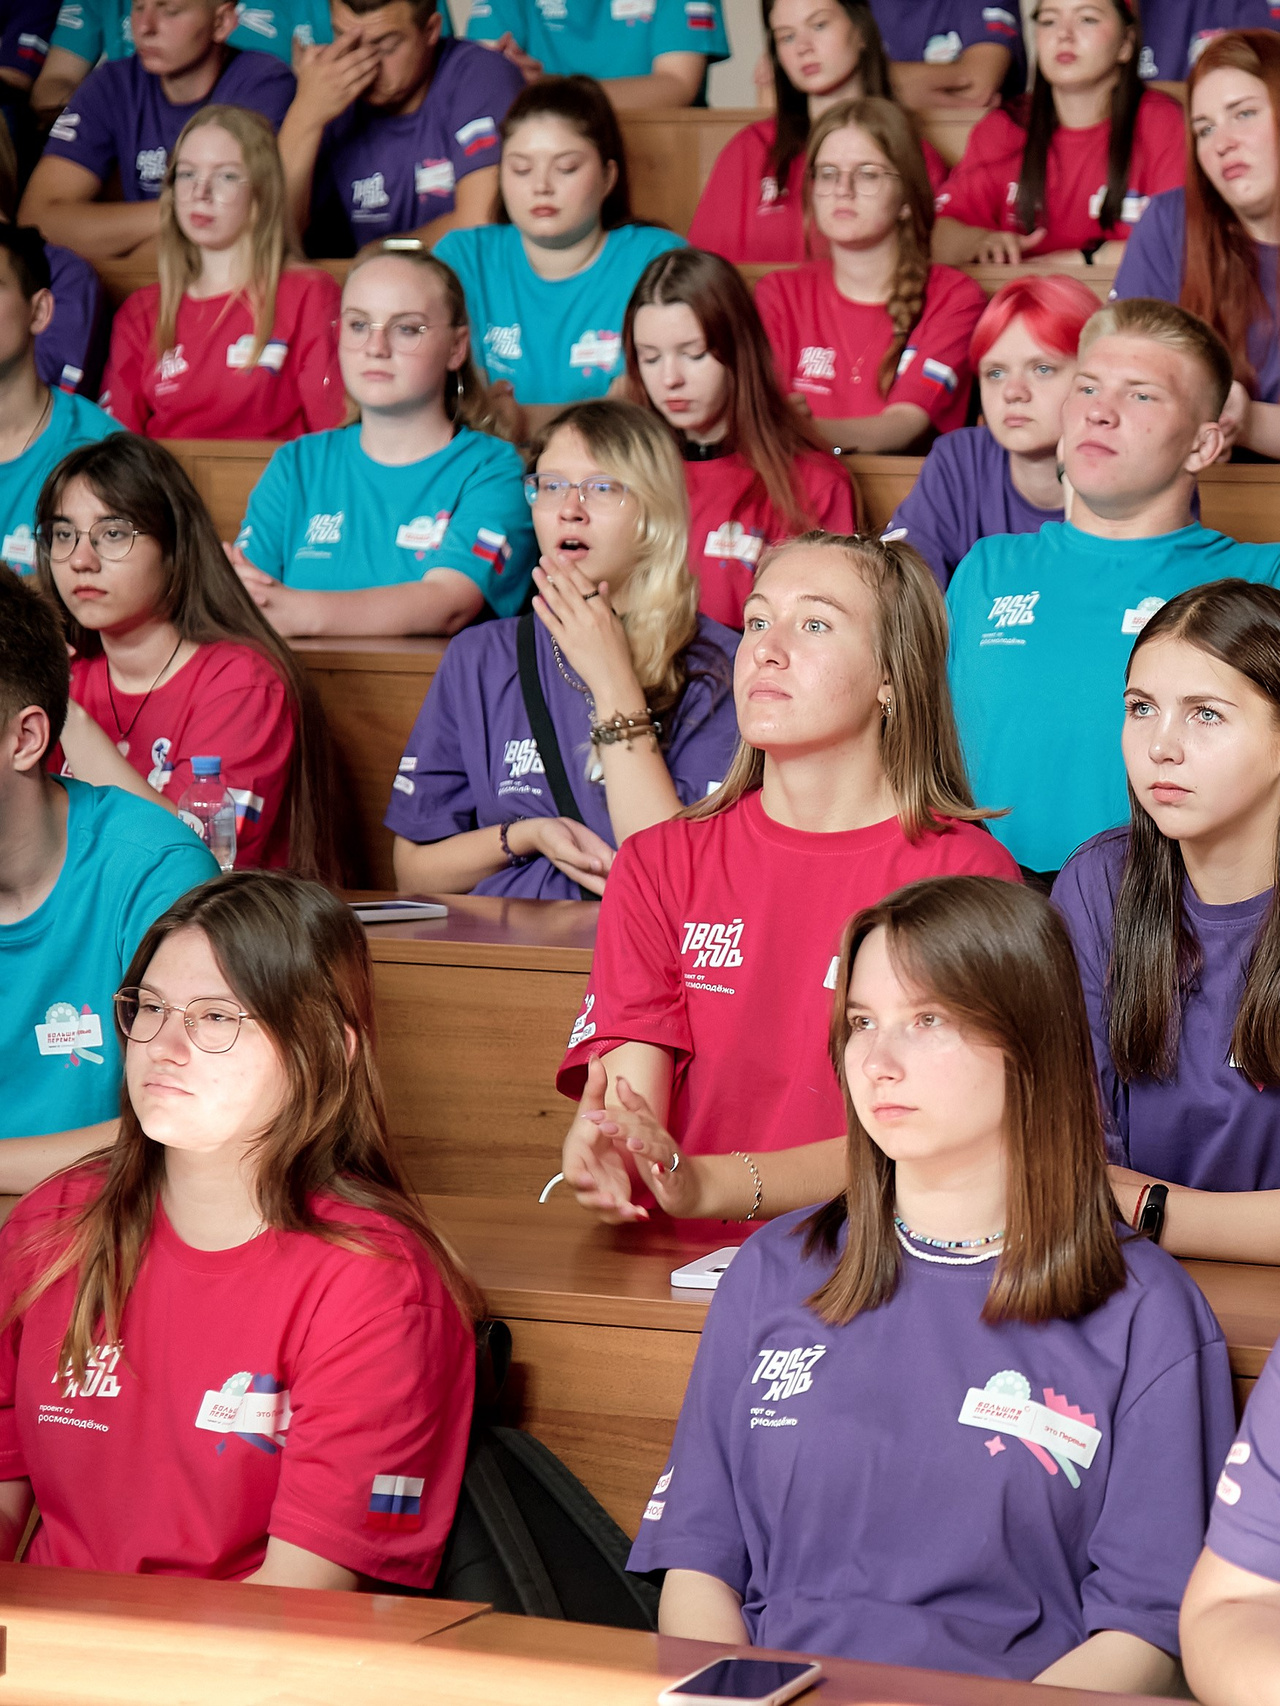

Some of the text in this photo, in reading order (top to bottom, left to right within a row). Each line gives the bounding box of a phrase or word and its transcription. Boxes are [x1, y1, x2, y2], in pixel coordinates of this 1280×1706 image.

[681, 918, 745, 955] ТВОЙ
[692, 948, 744, 968] ХОД
[751, 1344, 827, 1385] ТВОЙ
[761, 1371, 814, 1401] ХОД
[974, 1407, 1020, 1421] ПЕРЕМЕНА
[977, 1401, 1023, 1416] БОЛЬШАЯ
[38, 1413, 110, 1433] росмолодёжь
